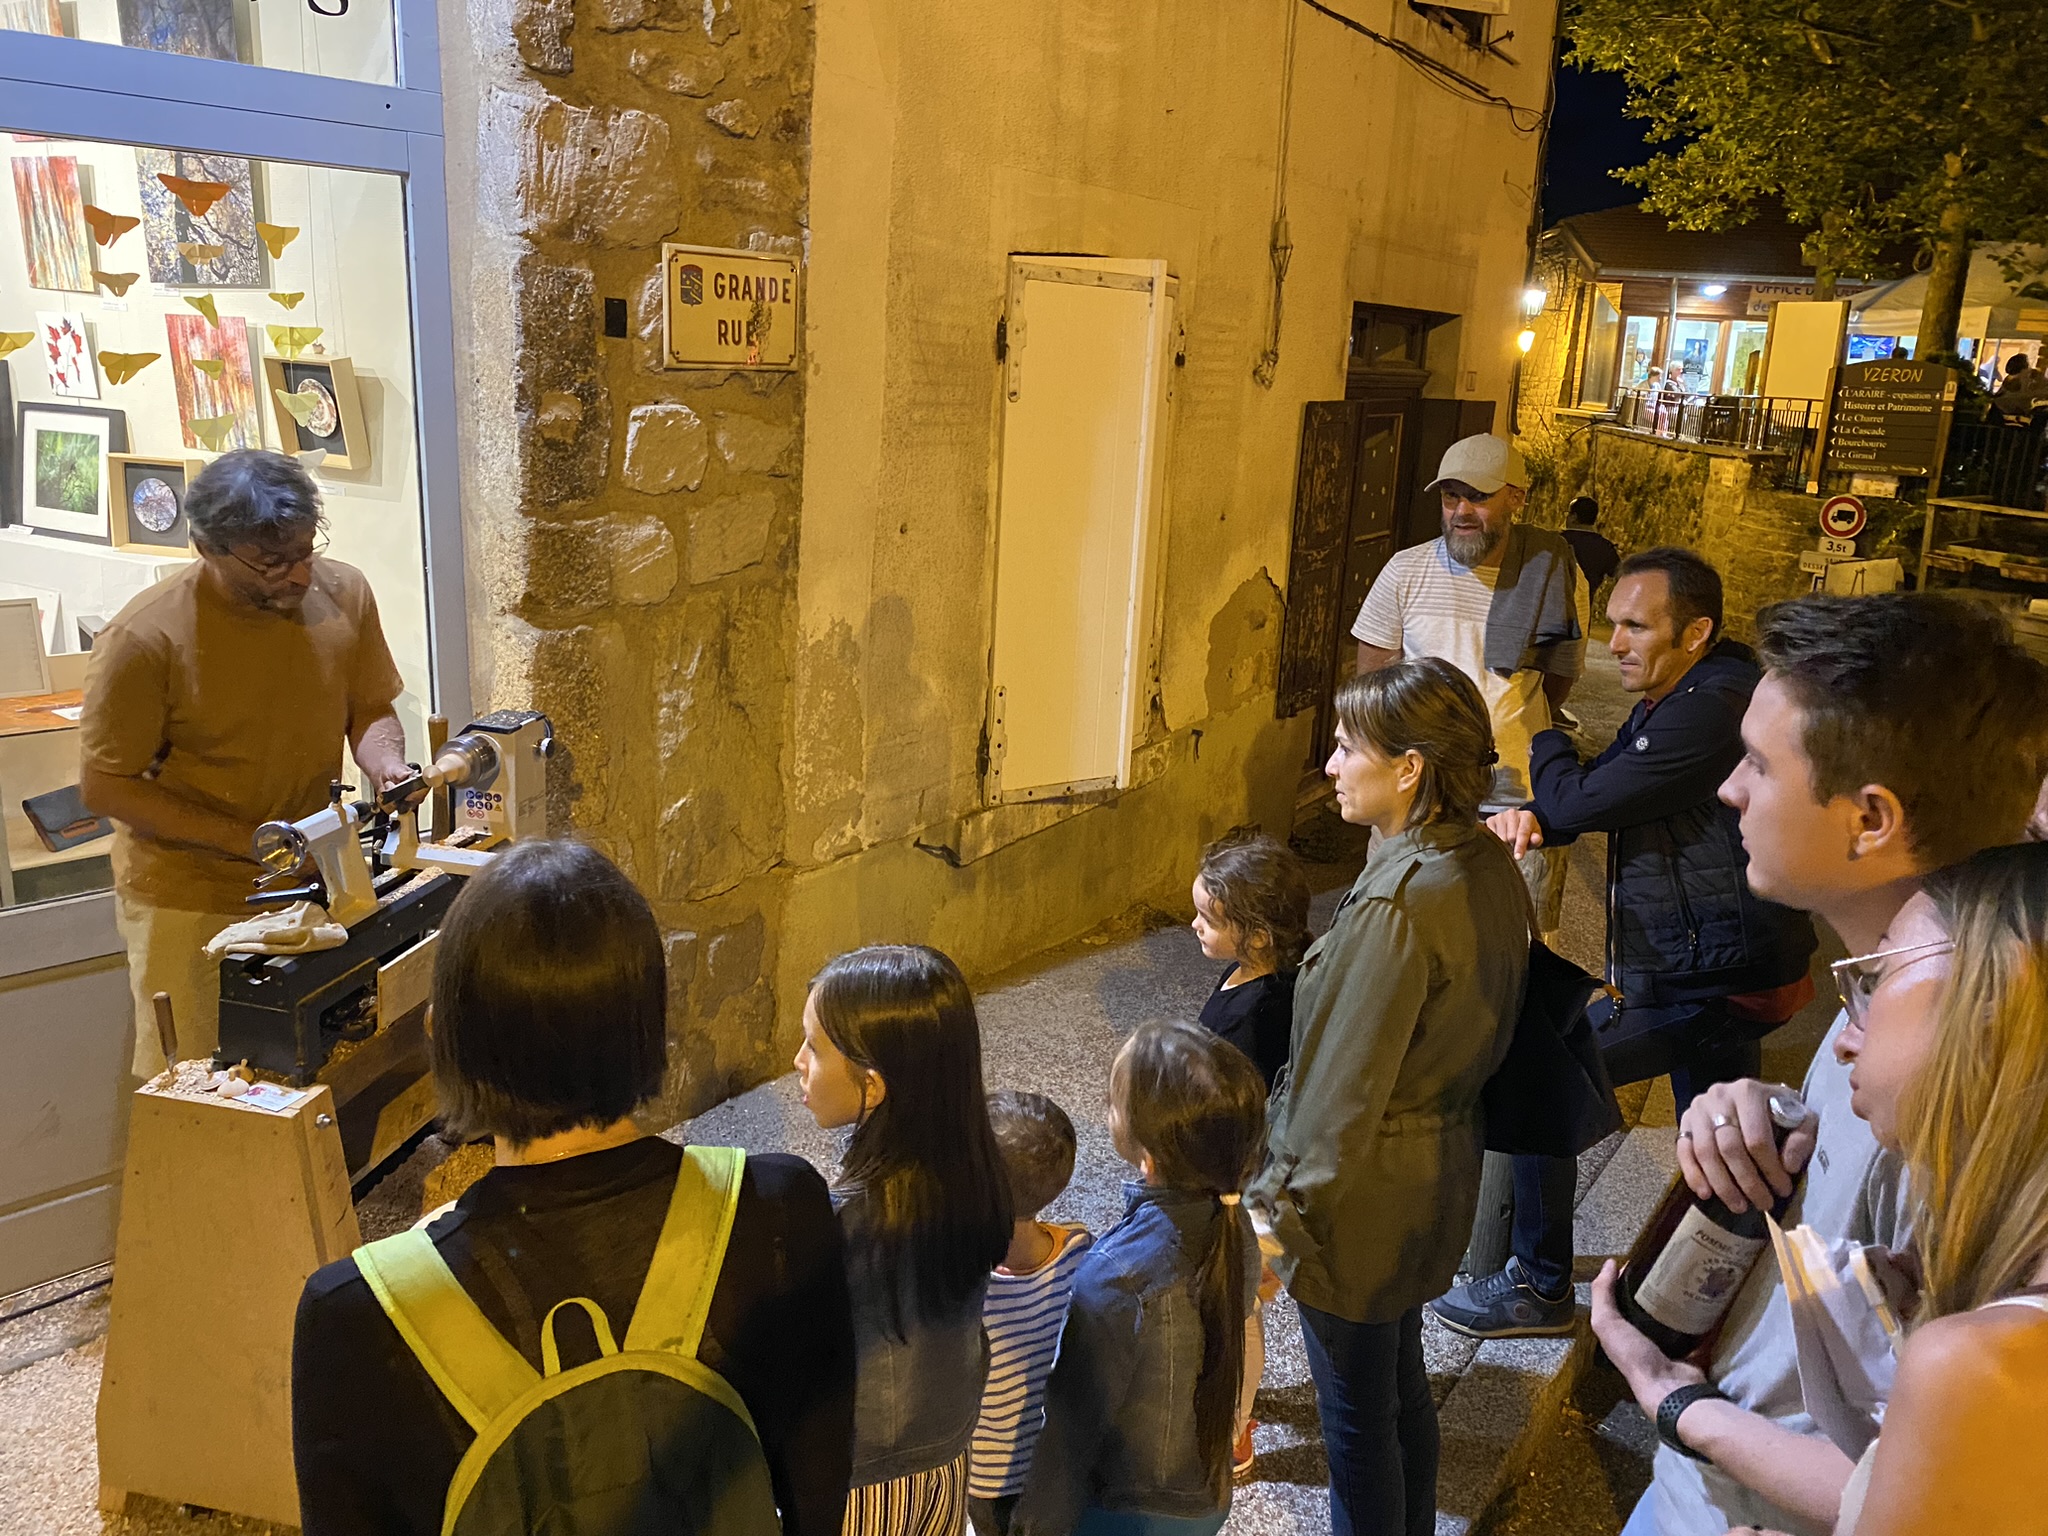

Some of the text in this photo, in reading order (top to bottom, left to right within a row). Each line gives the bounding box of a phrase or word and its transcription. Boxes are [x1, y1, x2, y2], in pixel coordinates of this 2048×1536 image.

[713, 272, 791, 304] GRANDE
[717, 319, 757, 347] RUE
[1863, 367, 1923, 383] YZERON
[1845, 389, 1886, 399] L'ARAIRE
[1843, 401, 1933, 413] Histoire et Patrimoine
[1841, 413, 1853, 422] Le
[1839, 426, 1886, 436] La Cascade
[1835, 451, 1847, 459] Le
[1826, 541, 1847, 553] 3,5t
